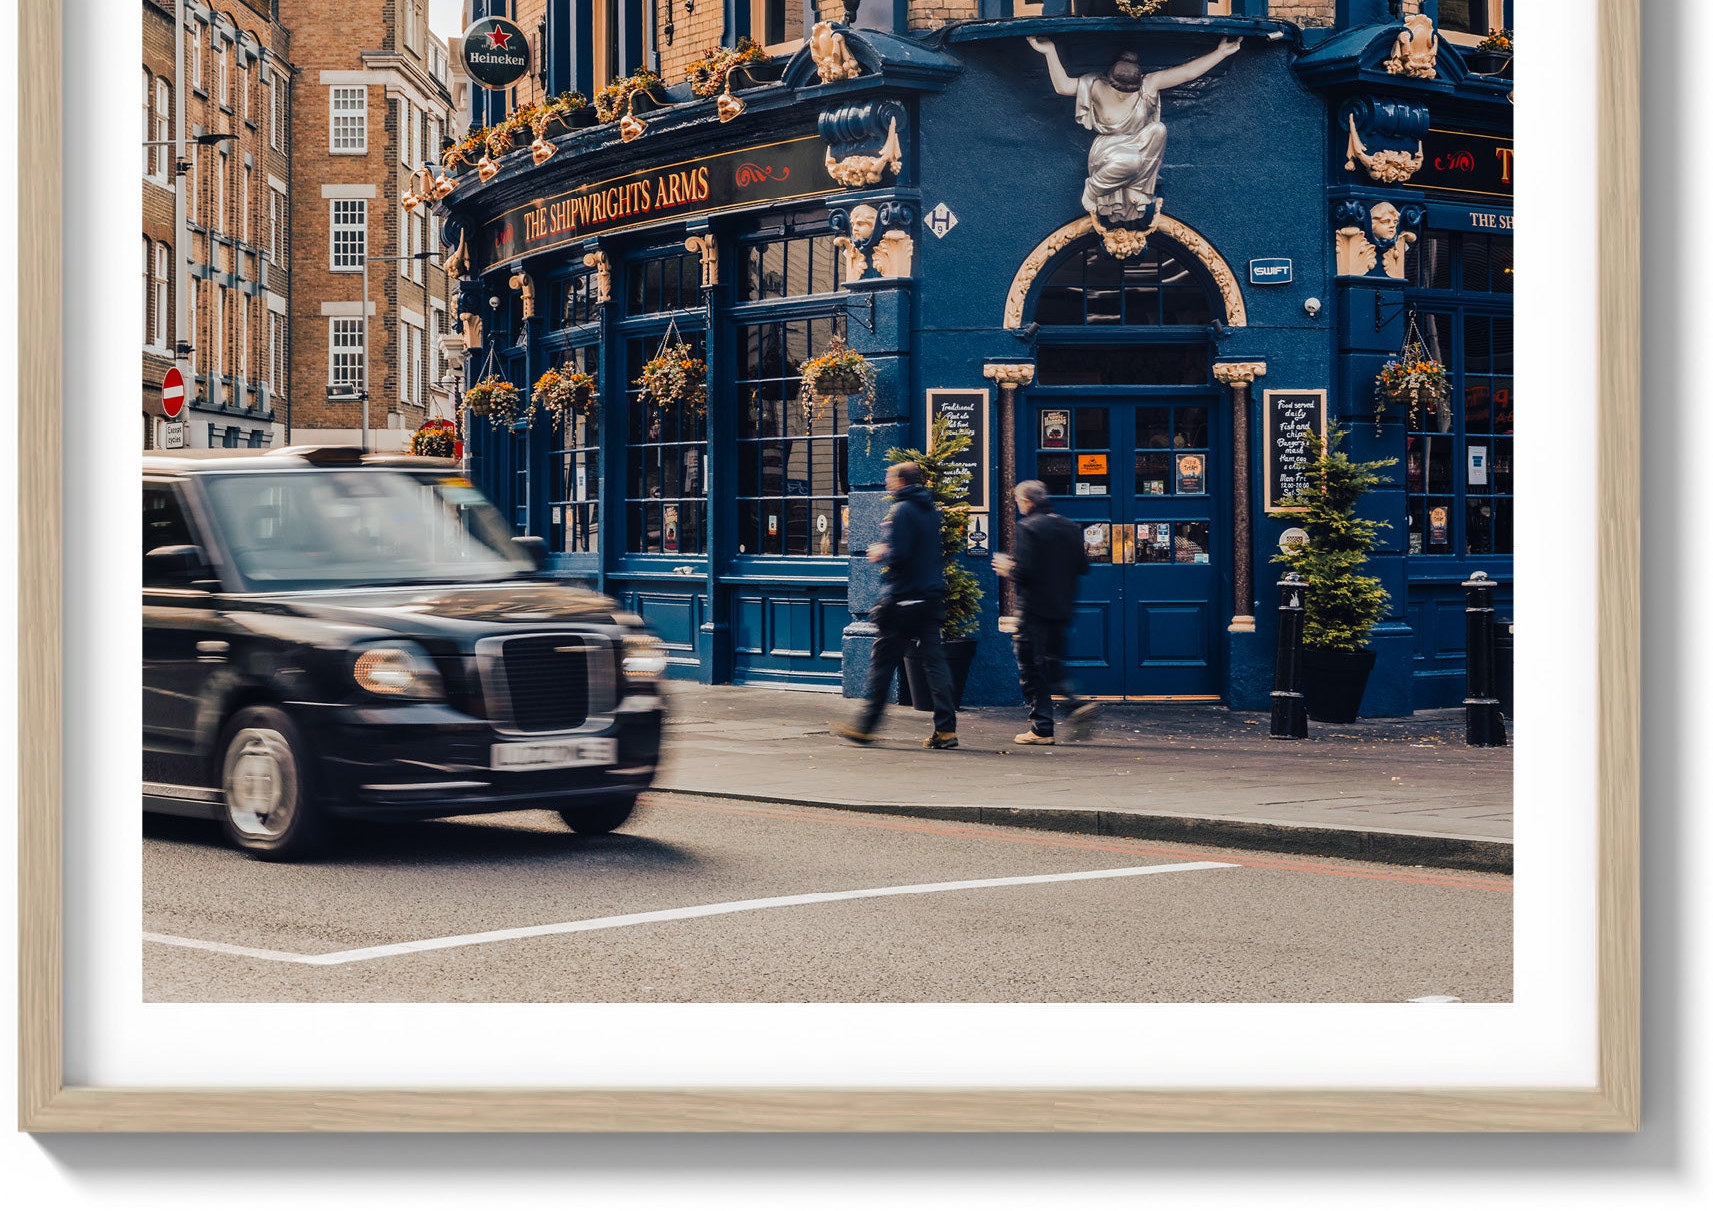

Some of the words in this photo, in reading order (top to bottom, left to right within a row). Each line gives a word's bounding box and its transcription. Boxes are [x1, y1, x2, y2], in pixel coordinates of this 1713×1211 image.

[470, 52, 525, 66] Heineken
[524, 207, 549, 243] THE
[550, 179, 651, 235] SHIPWRIGHTS
[654, 166, 710, 209] ARMS
[932, 210, 950, 230] H
[1470, 212, 1496, 228] THE
[1254, 266, 1289, 276] SWIFT
[1278, 400, 1293, 410] Food
[1294, 400, 1315, 409] served
[1285, 409, 1306, 421] daily
[1280, 420, 1295, 430] Fish
[1296, 421, 1311, 430] and
[168, 426, 182, 435] Except
[1286, 430, 1307, 440] chips
[168, 436, 181, 444] cycles
